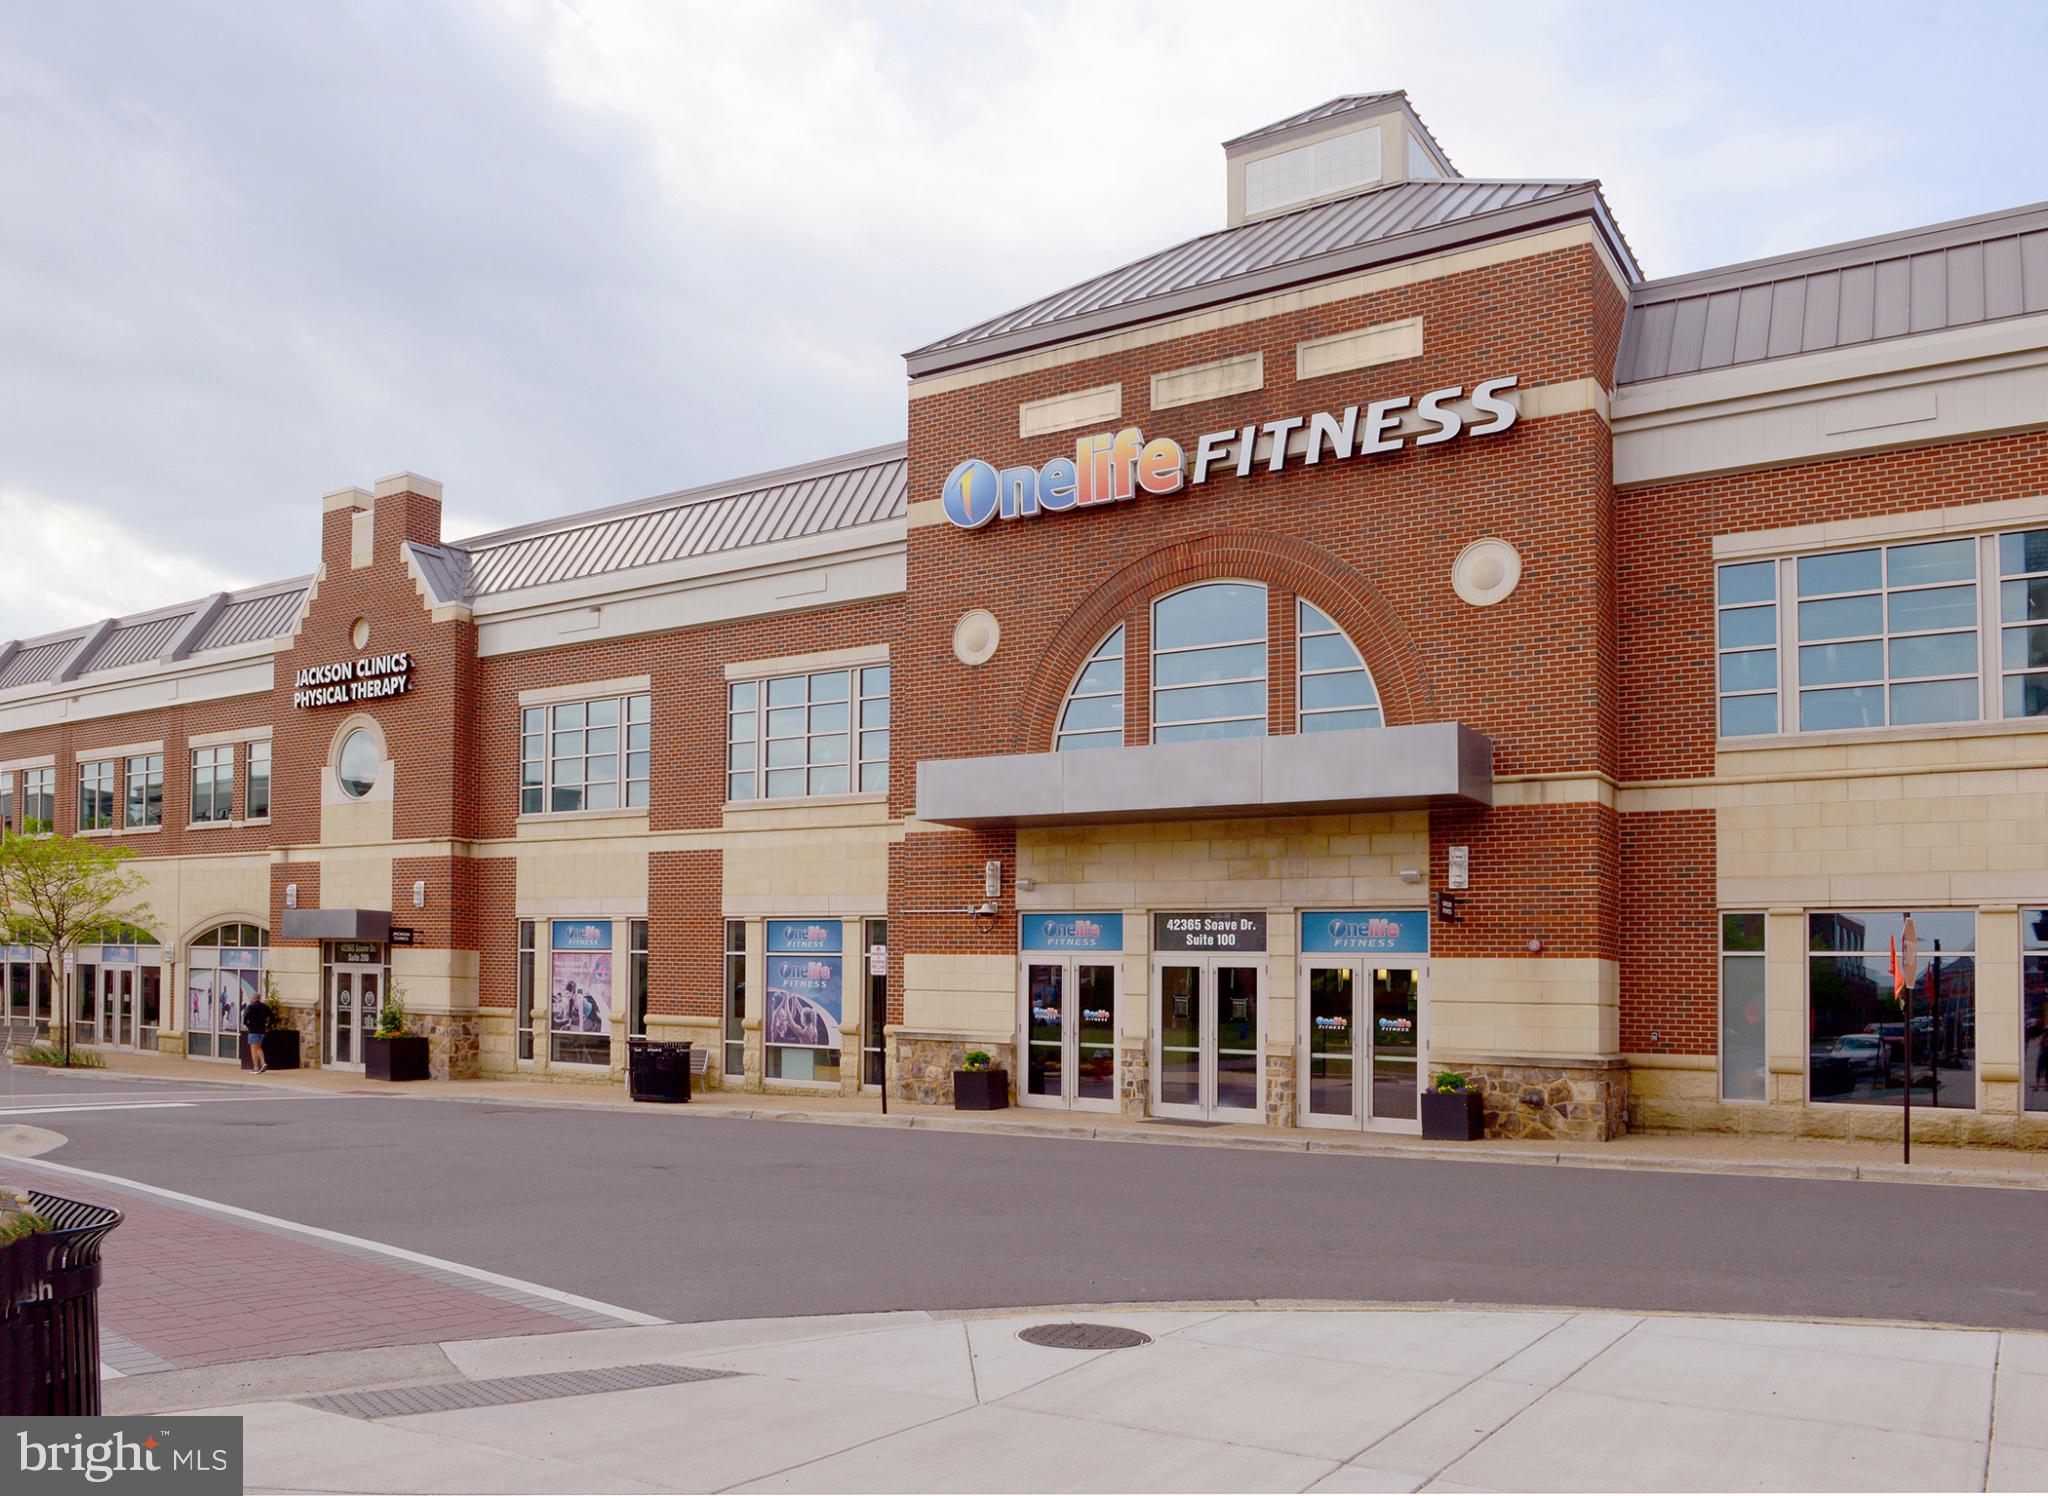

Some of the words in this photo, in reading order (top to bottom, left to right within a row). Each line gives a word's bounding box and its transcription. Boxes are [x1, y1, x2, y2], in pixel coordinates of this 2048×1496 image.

[941, 427, 1187, 529] Onelife
[1192, 375, 1519, 484] FITNESS
[295, 662, 352, 687] JACKSON
[356, 653, 407, 676] CLINICS
[294, 685, 349, 708] PHYSICAL
[350, 675, 407, 700] THERAPY
[1043, 920, 1100, 938] Onelife
[1166, 919, 1201, 931] 42365
[1204, 919, 1237, 931] Soave
[1240, 919, 1257, 931] Dr.
[1328, 919, 1400, 938] Onelife
[1047, 938, 1097, 946] FITNESS
[1186, 934, 1214, 946] Suite
[1216, 934, 1236, 946] 100
[1333, 939, 1395, 947] FITNESS
[782, 980, 827, 989] FITNESS
